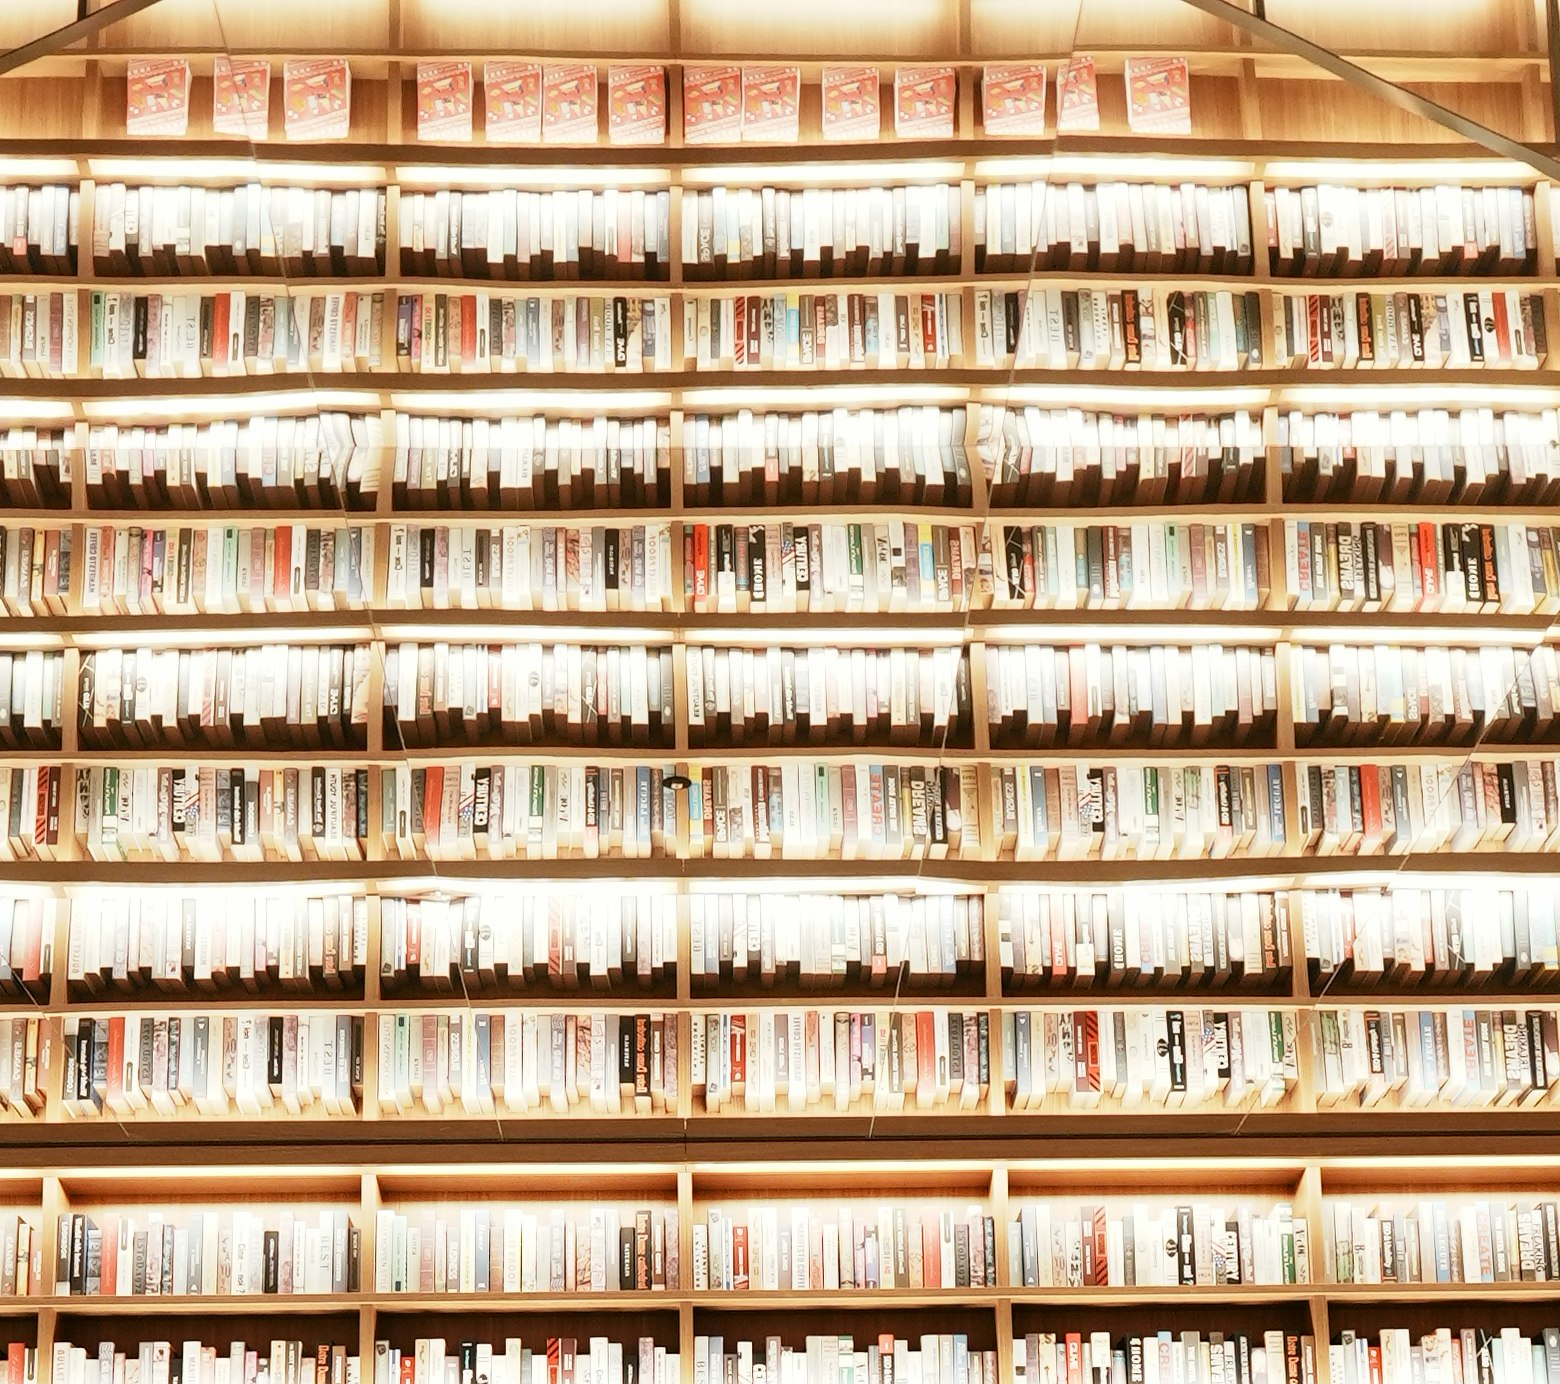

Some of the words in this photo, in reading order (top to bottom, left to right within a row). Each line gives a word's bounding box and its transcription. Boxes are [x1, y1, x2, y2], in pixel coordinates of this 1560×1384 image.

[320, 1236, 329, 1271] BEST
[1225, 1231, 1239, 1280] CENTURY
[1479, 1212, 1492, 1275] CREATE
[1534, 1224, 1545, 1272] FREAKING
[797, 1264, 805, 1288] COFFEE
